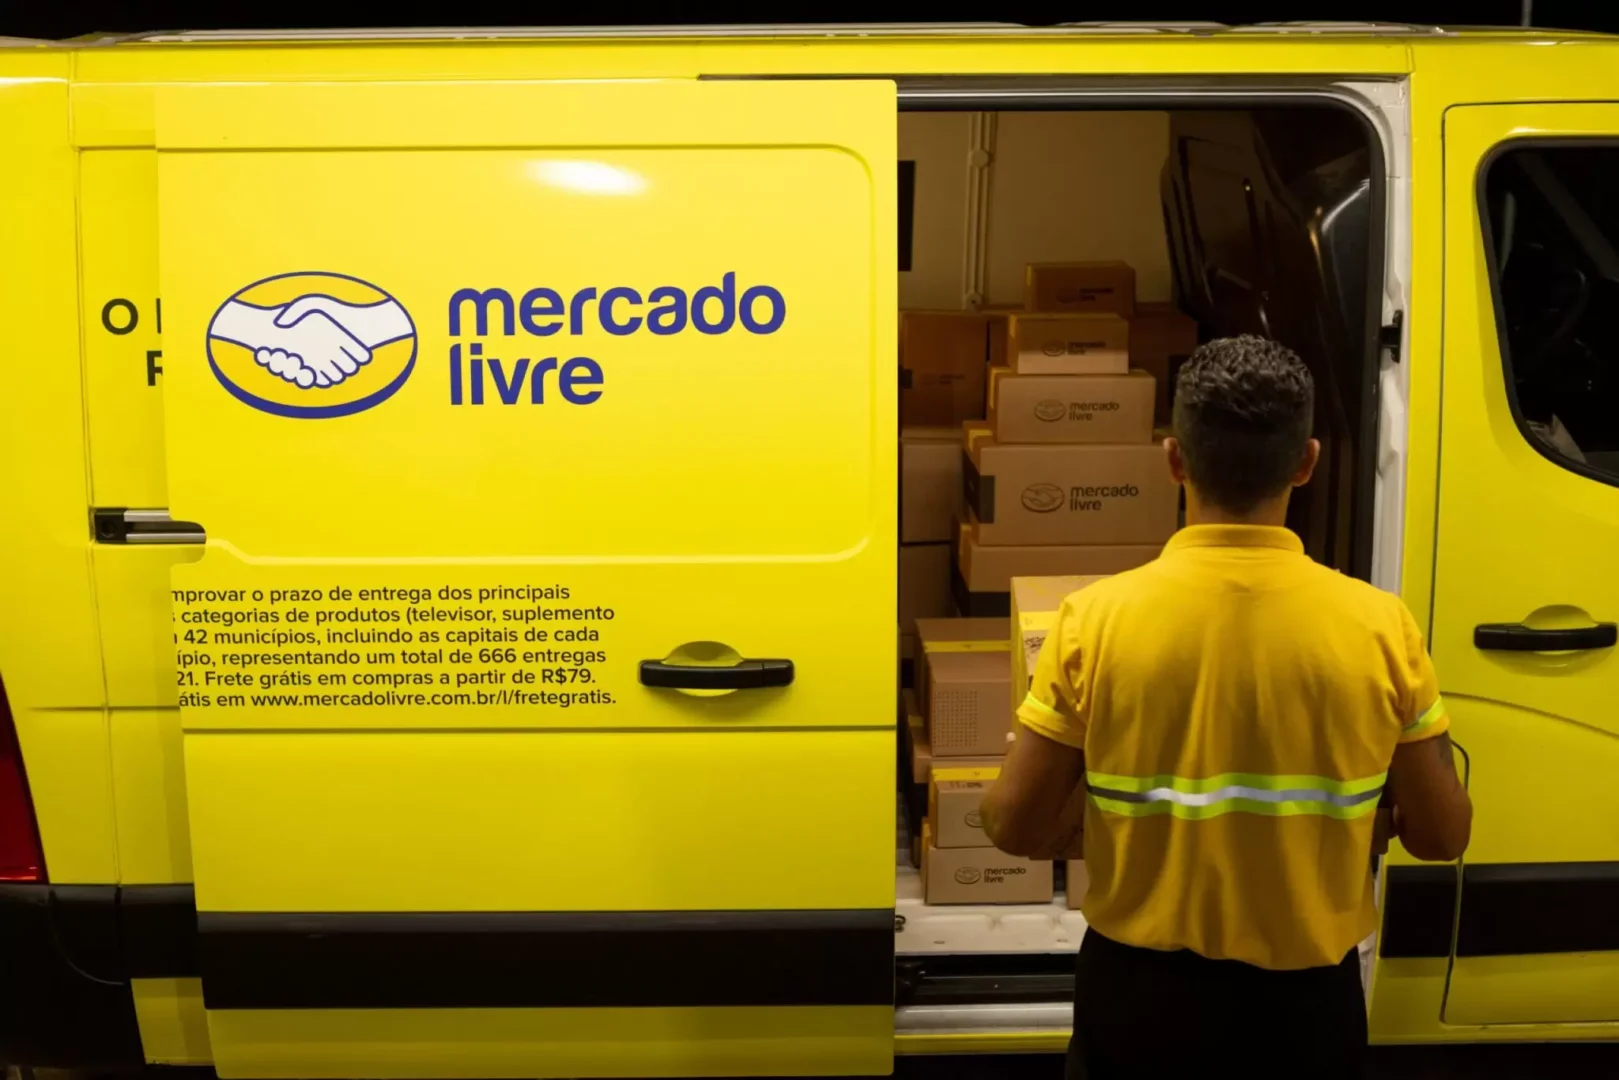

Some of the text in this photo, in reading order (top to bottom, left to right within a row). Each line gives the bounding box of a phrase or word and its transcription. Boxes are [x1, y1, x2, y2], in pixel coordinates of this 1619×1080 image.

[448, 271, 786, 337] mercado
[101, 297, 139, 336] O
[449, 342, 605, 406] livre
[1069, 401, 1120, 412] mercado
[1070, 483, 1139, 497] mercado
[1070, 497, 1102, 512] livre
[251, 589, 264, 602] o
[269, 589, 324, 606] prazo
[328, 585, 353, 602] de
[358, 586, 432, 605] entrega
[437, 584, 473, 601] dos
[478, 583, 571, 604] principais
[180, 607, 280, 627] categorias
[285, 607, 310, 623] de
[315, 606, 401, 627] produtos
[406, 606, 497, 626] (televisor,
[502, 605, 615, 625] suplemento
[183, 628, 209, 645] 42
[214, 628, 321, 648] municípios,
[326, 627, 413, 644] incluindo
[418, 630, 441, 644] as
[445, 626, 519, 647] capitais
[523, 626, 549, 643] de
[553, 626, 600, 642] cada
[221, 649, 361, 669] representando
[366, 652, 396, 665] um
[400, 648, 443, 665] total
[448, 648, 473, 664] de
[478, 647, 517, 664] 666
[522, 648, 607, 667] entregas
[204, 670, 254, 687] Frete
[259, 670, 313, 690] grátis
[317, 673, 347, 686] em
[352, 673, 434, 689] compras
[439, 672, 450, 685] a
[456, 669, 507, 689] partir
[511, 668, 536, 684] de
[541, 666, 596, 686] R$79.
[216, 695, 246, 707] em
[250, 688, 617, 709] www.mercadolivre.com.br/l/fretegratis.
[984, 866, 1027, 875] mercado
